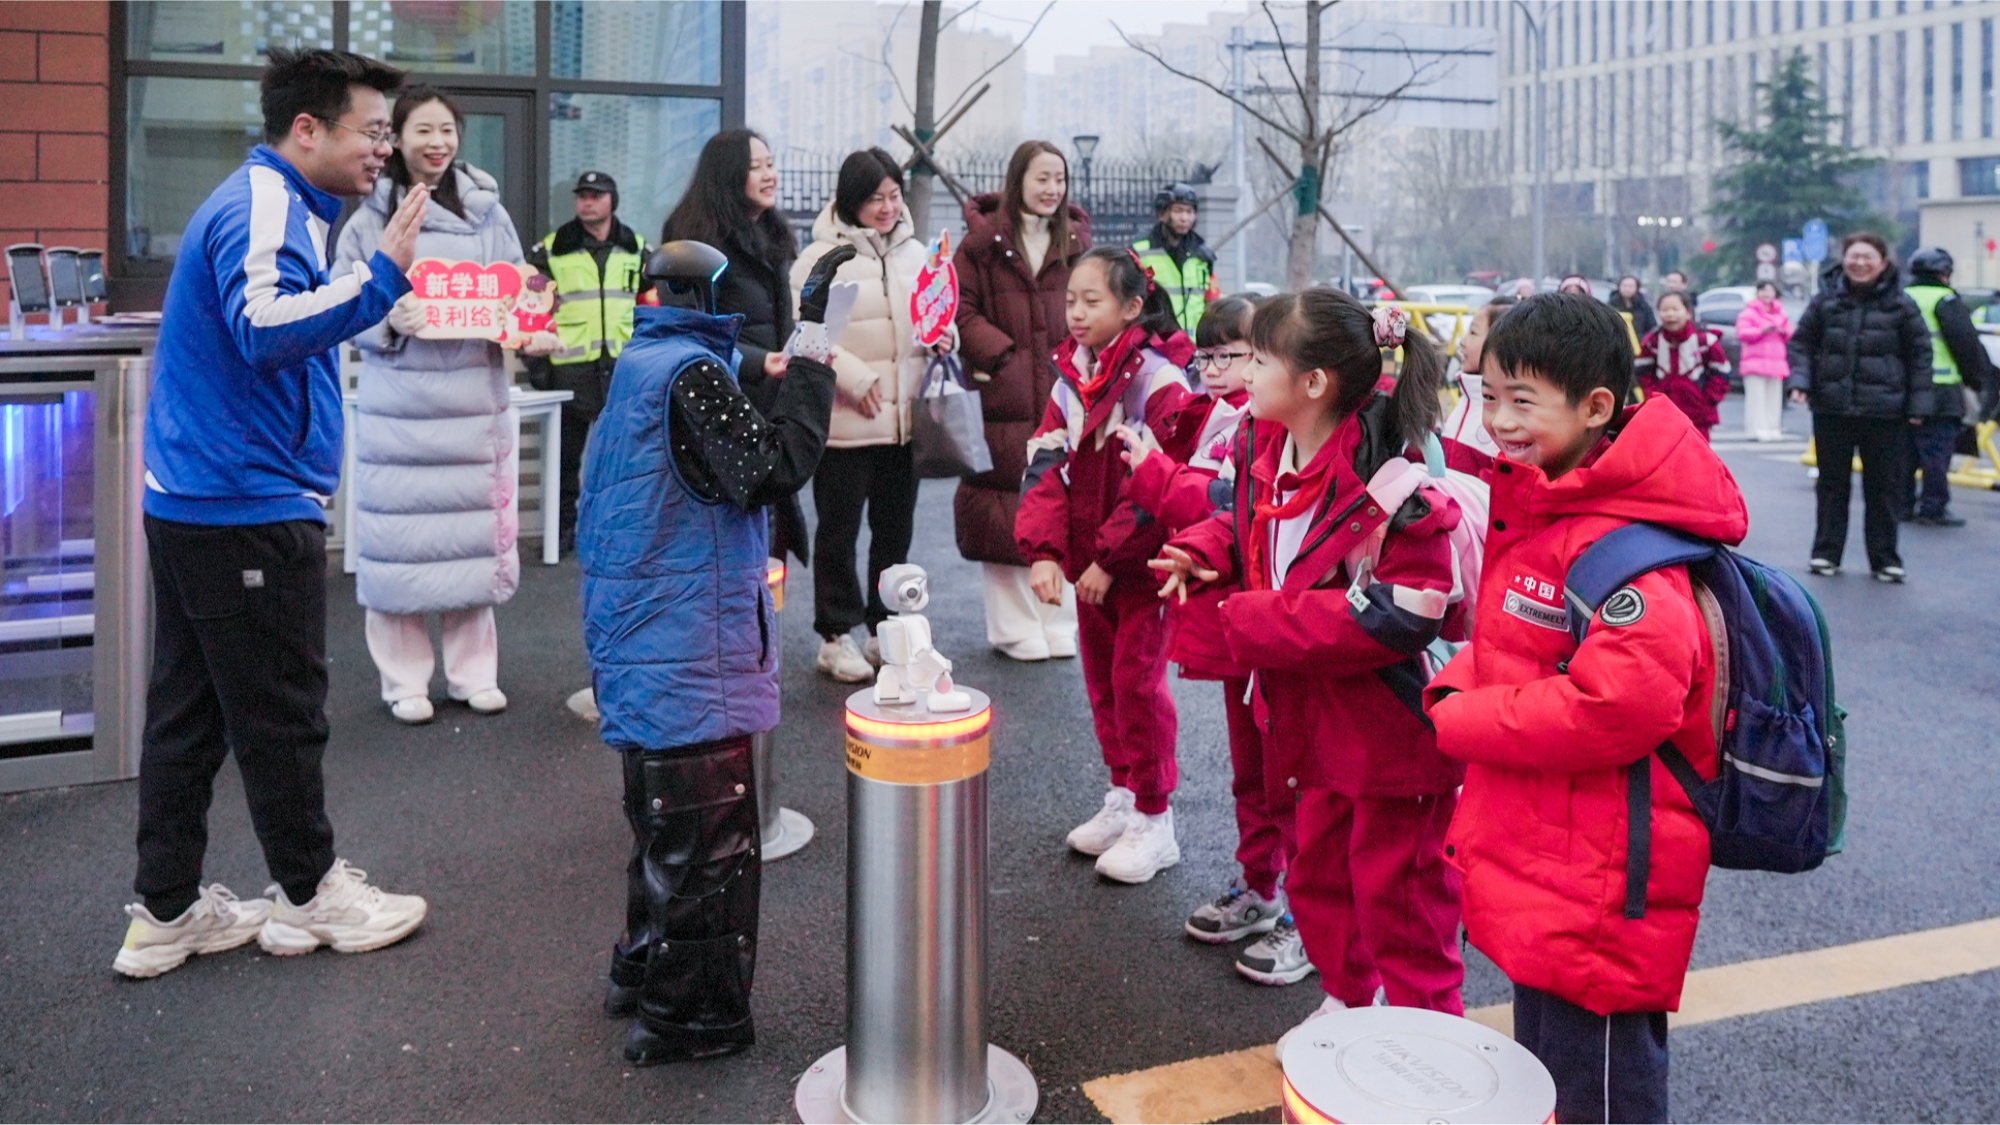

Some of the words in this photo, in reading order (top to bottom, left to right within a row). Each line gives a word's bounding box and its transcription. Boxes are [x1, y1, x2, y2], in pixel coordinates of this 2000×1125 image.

[425, 272, 499, 297] 新学期
[425, 305, 493, 328] 奥利给
[1523, 576, 1556, 601] 中国
[1519, 603, 1566, 625] EXTREMELY
[1375, 1038, 1477, 1100] HIKVISION
